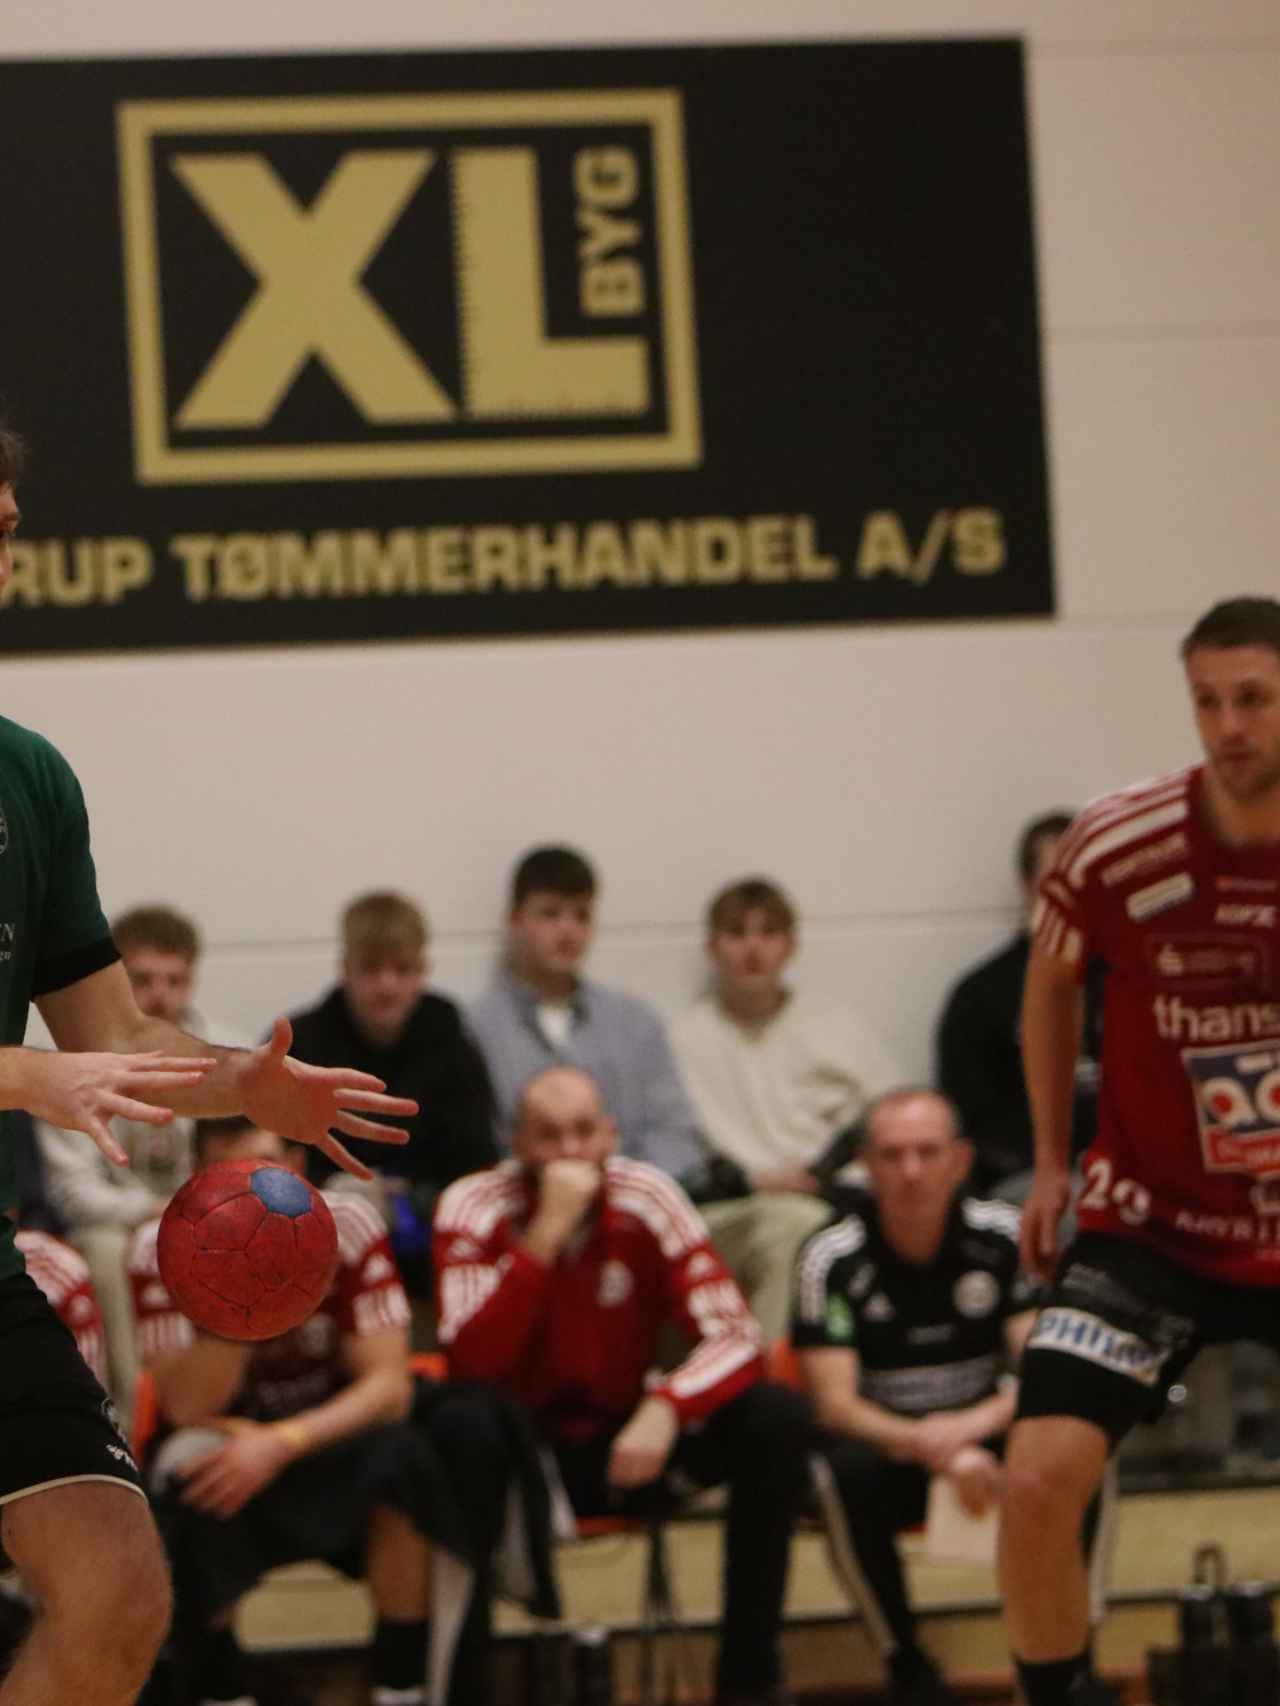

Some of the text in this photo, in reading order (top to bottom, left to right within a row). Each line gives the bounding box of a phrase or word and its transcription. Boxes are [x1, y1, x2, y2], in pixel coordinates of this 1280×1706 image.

[172, 147, 651, 429] XL
[573, 147, 645, 317] BYG
[170, 516, 836, 601] TØMMERHANDEL
[858, 509, 1004, 578] A/S
